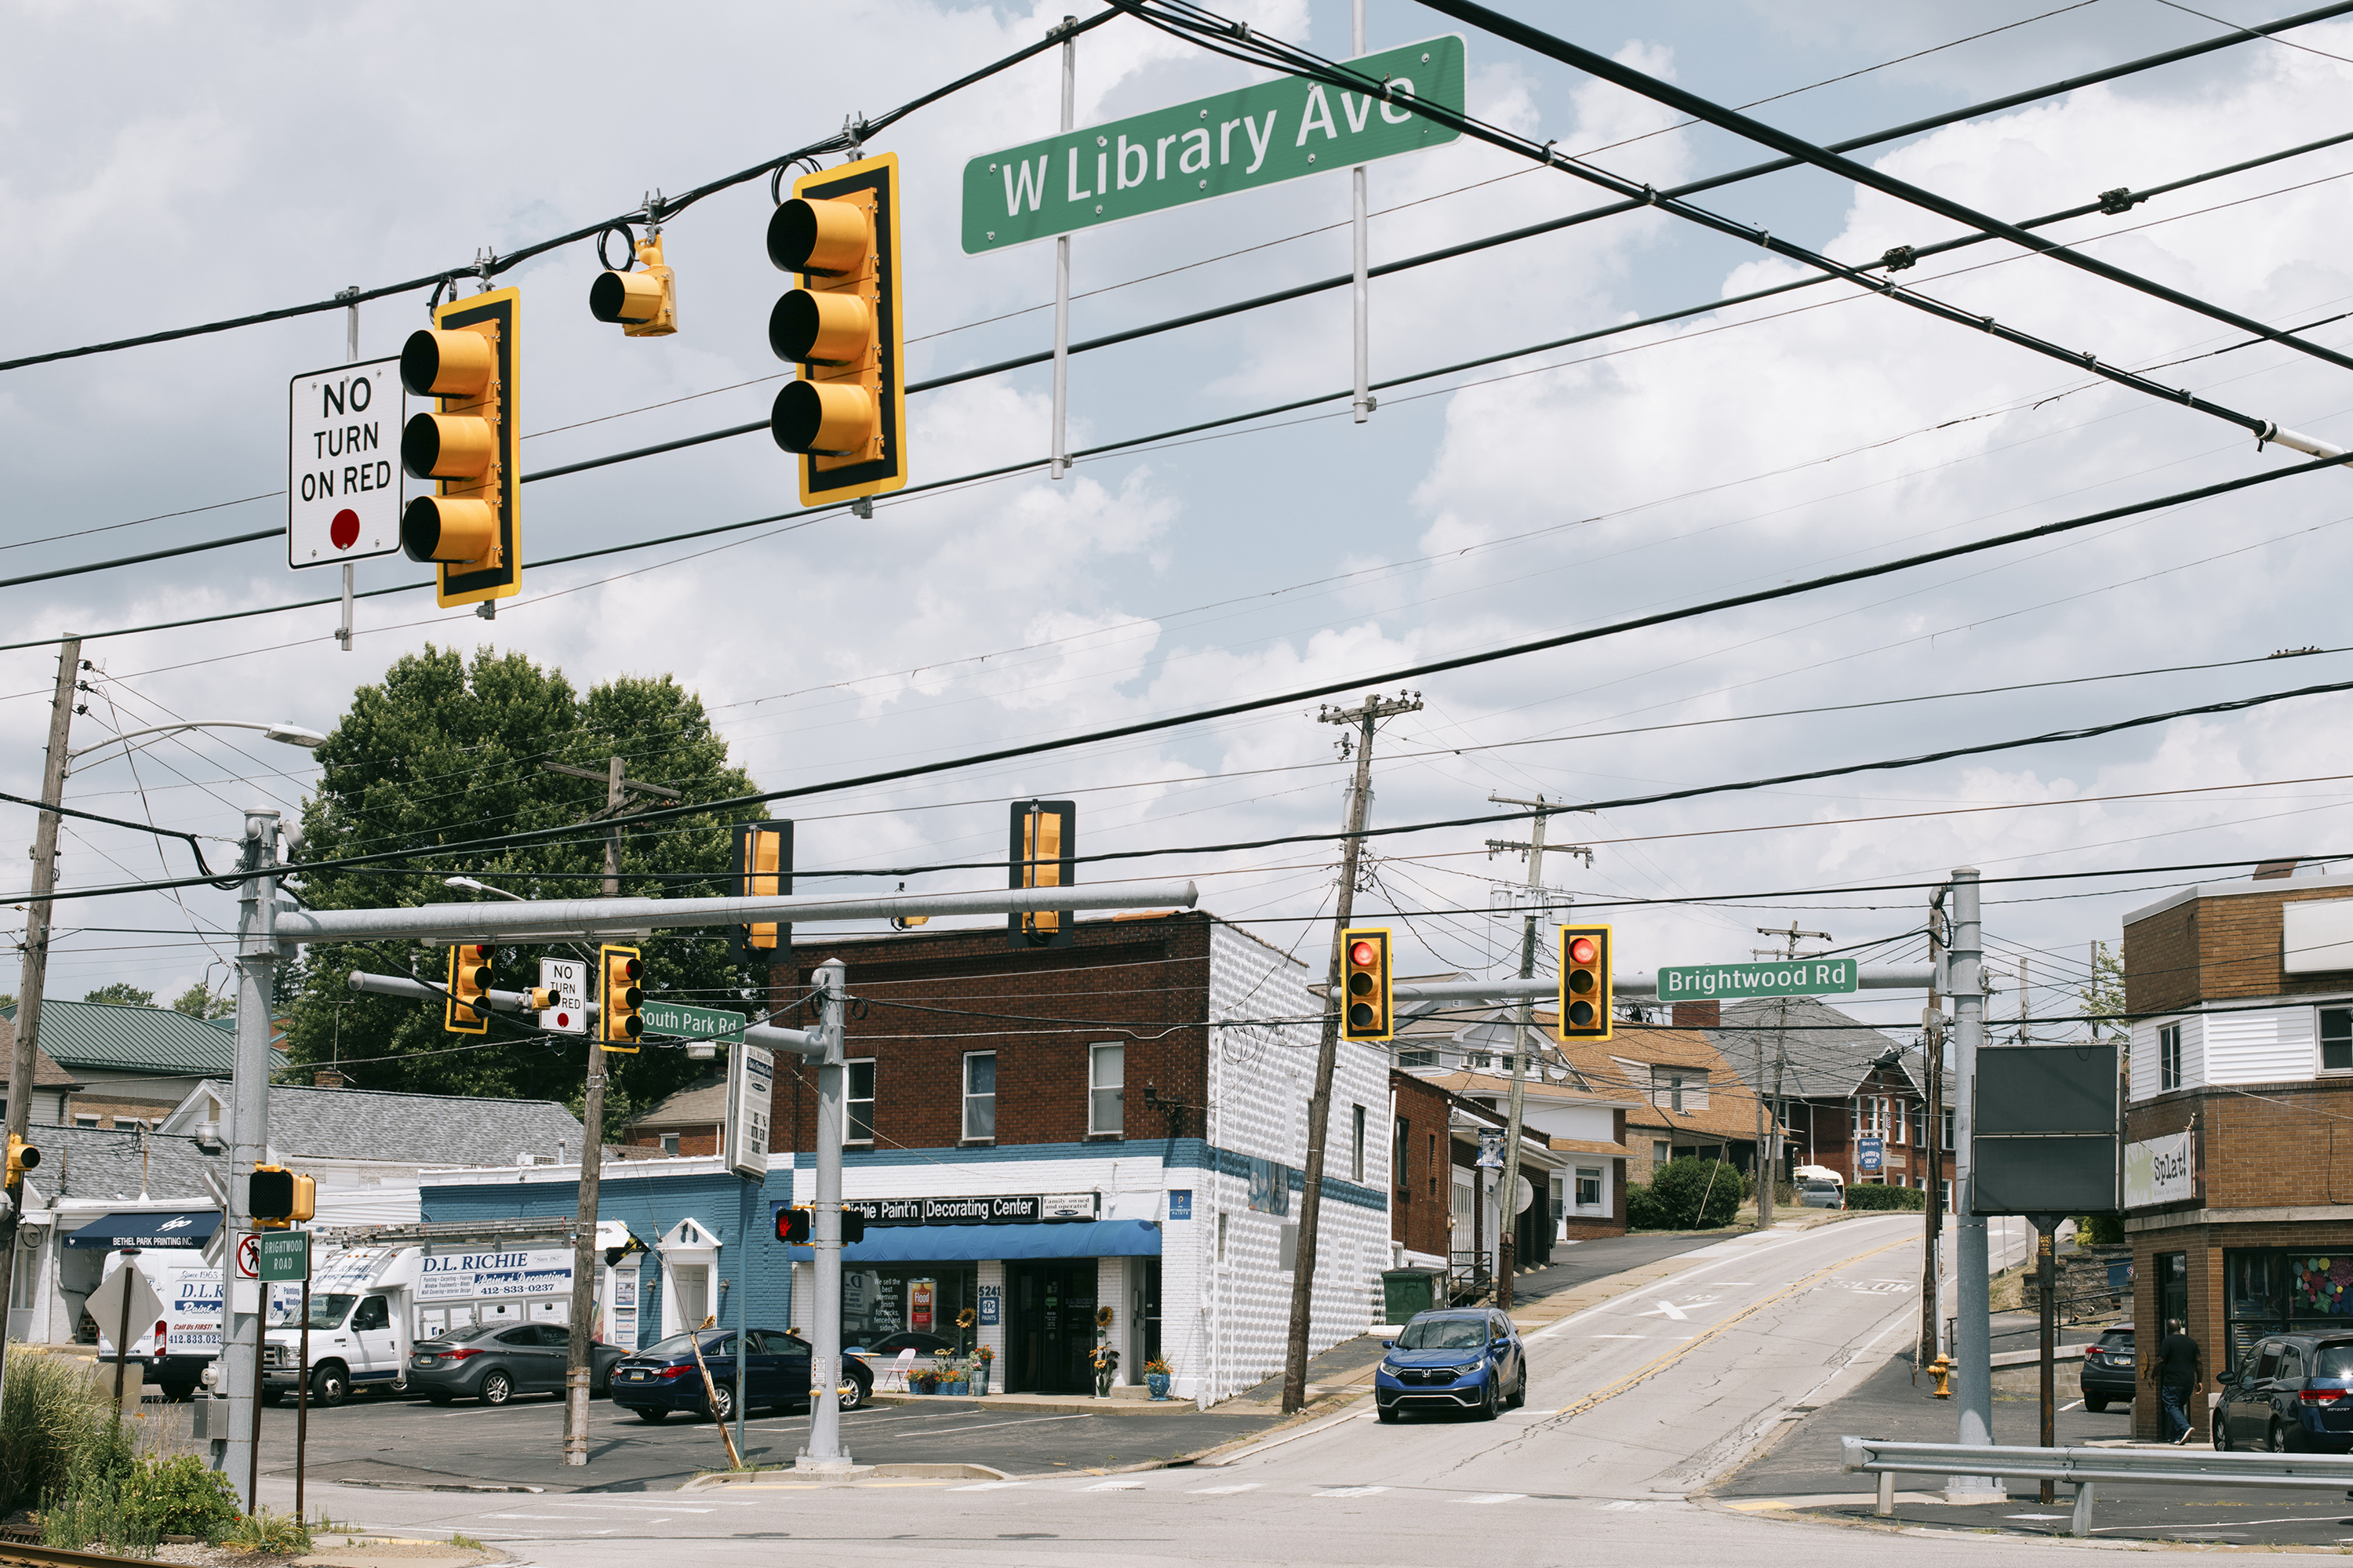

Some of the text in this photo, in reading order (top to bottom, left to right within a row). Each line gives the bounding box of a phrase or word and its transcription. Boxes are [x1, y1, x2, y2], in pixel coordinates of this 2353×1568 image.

[1002, 77, 1415, 216] W Library Ave
[324, 377, 372, 418] NO
[314, 421, 378, 459] TURN
[301, 460, 391, 501] ON RED
[554, 965, 573, 979] NO
[1668, 964, 1846, 995] Brightwood Rd
[551, 982, 576, 994] TURN
[562, 998, 580, 1009] RED
[639, 1007, 736, 1035] South Park Rd
[1860, 1150, 1881, 1160] BARBER
[2154, 1141, 2187, 1186] Splat!
[926, 1199, 989, 1220] Decorating
[993, 1199, 1033, 1216] Center
[113, 1237, 194, 1246] BETHEL PARK PRINTING INC.
[264, 1239, 304, 1253] BRIGHTWOOD
[274, 1257, 293, 1270] ROAD
[423, 1253, 528, 1271] D.L. RICHIE
[180, 1270, 218, 1279] Since 1963
[477, 1273, 505, 1286] Paint
[517, 1271, 566, 1285] Decorating
[283, 1286, 300, 1296] Painting
[481, 1283, 555, 1294] 412-833-0237
[978, 1286, 1002, 1297] 5241
[1833, 1280, 1917, 1293] SLOW
[914, 1291, 930, 1303] Flood
[182, 1301, 213, 1315] Paint
[983, 1301, 995, 1312] PPG
[169, 1334, 221, 1344] 412.833.023
